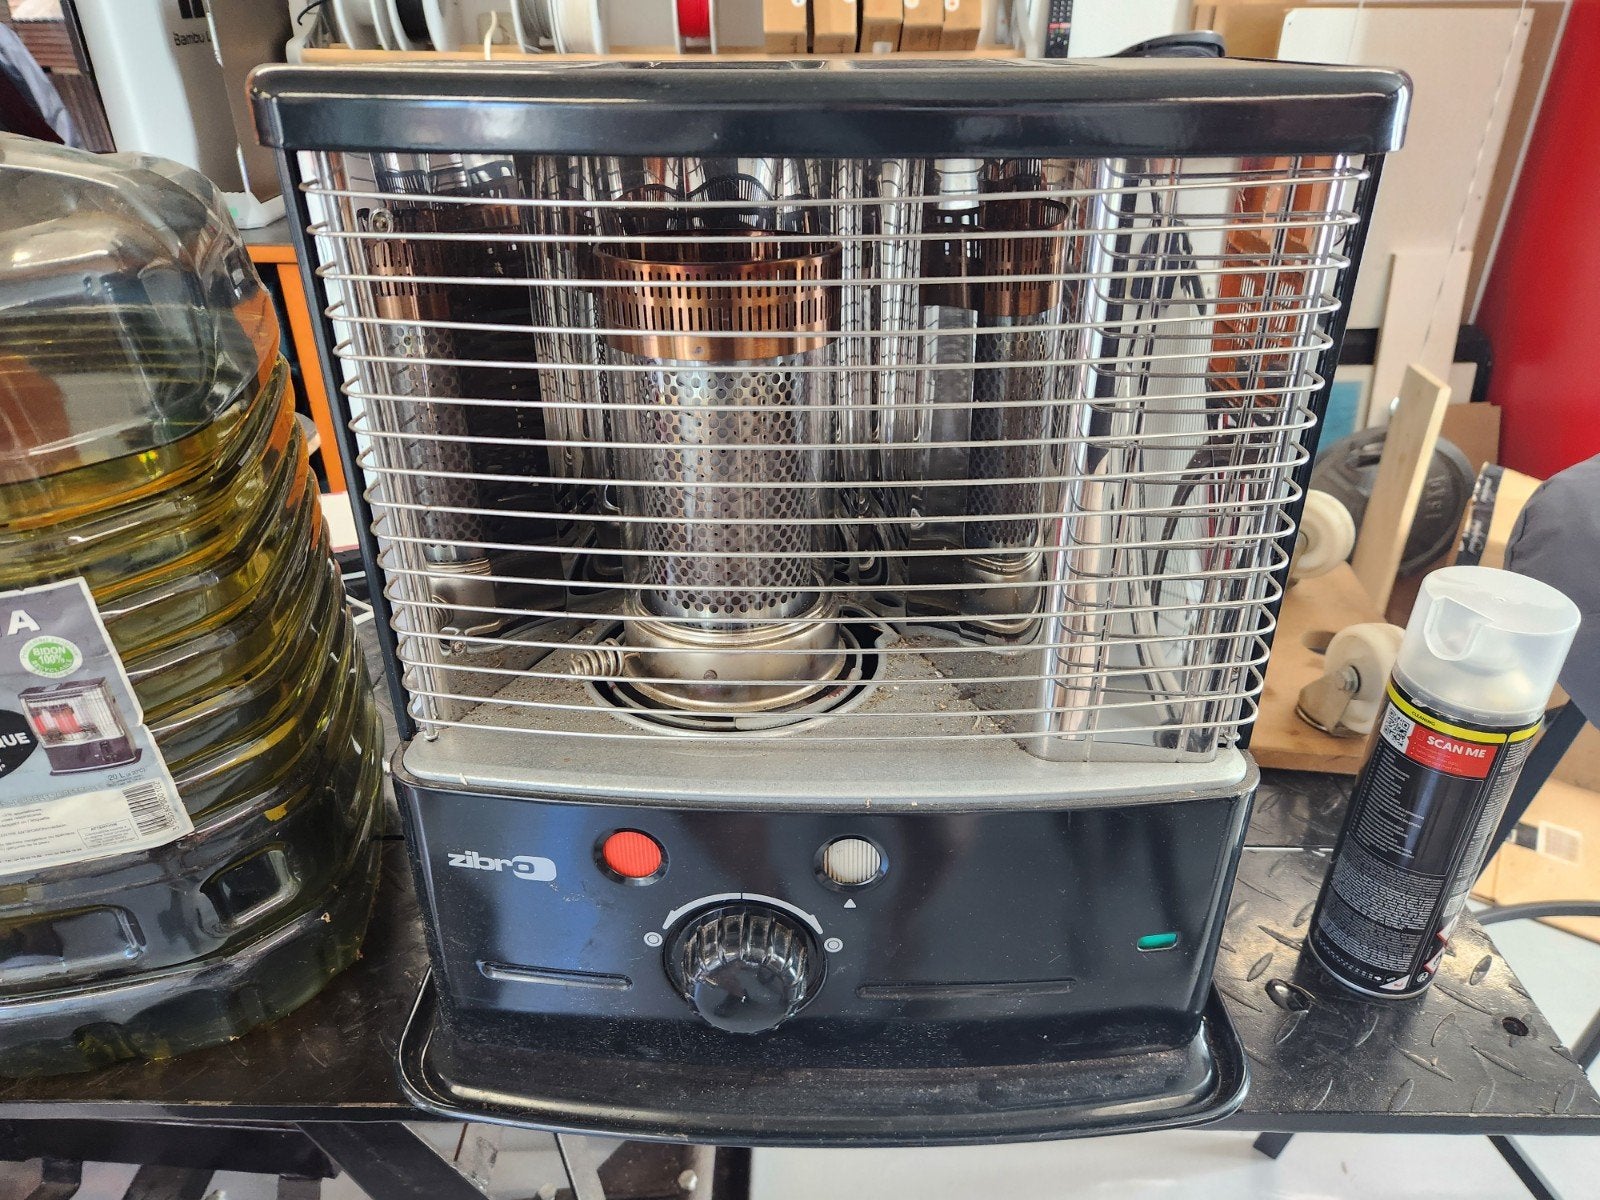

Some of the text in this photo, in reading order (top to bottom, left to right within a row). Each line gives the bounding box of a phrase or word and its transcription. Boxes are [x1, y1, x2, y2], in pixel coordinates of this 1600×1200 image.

[173, 31, 205, 46] Bambu
[32, 646, 66, 656] BIDON
[38, 653, 66, 664] 100%
[1411, 710, 1436, 727] CLEANING
[1427, 736, 1486, 758] SCAN ME
[107, 773, 118, 781] 20
[447, 850, 557, 882] zibro
